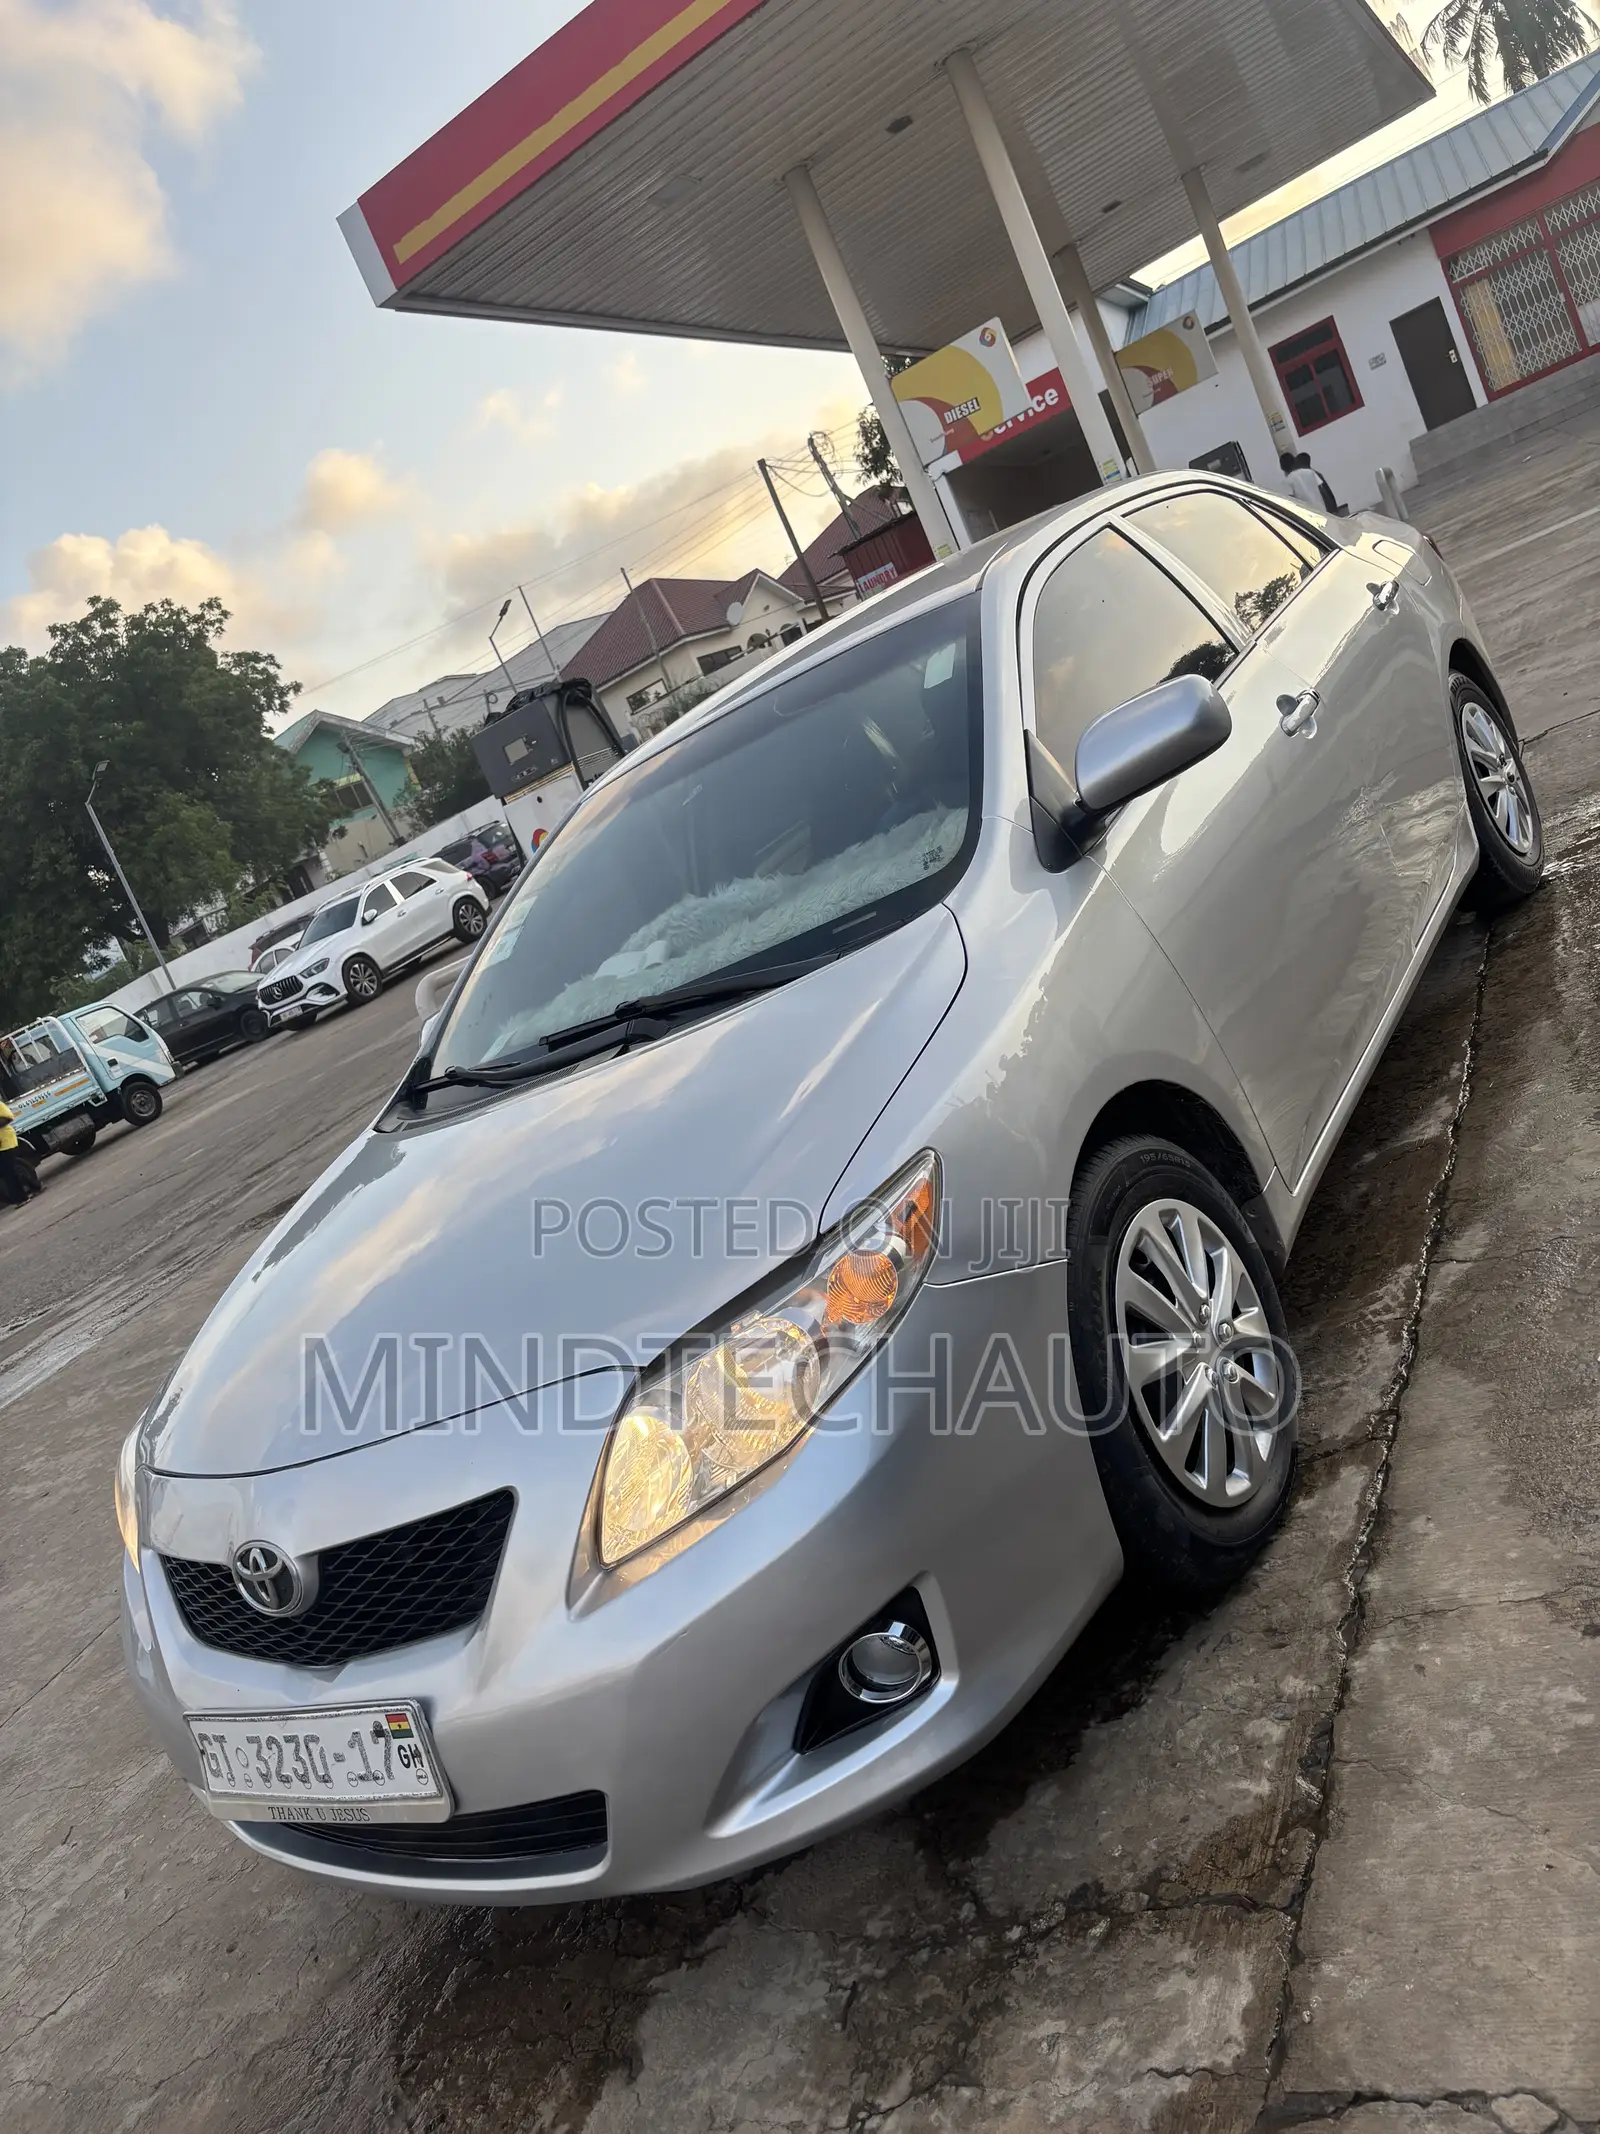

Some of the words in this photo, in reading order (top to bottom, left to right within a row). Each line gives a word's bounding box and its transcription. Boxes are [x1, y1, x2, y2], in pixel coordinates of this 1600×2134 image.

[943, 398, 981, 424] DIESEL
[198, 1732, 236, 1781] GT
[398, 1744, 424, 1768] GH
[268, 1806, 314, 1821] THANK
[316, 1808, 327, 1821] U
[331, 1808, 371, 1822] JESUS
